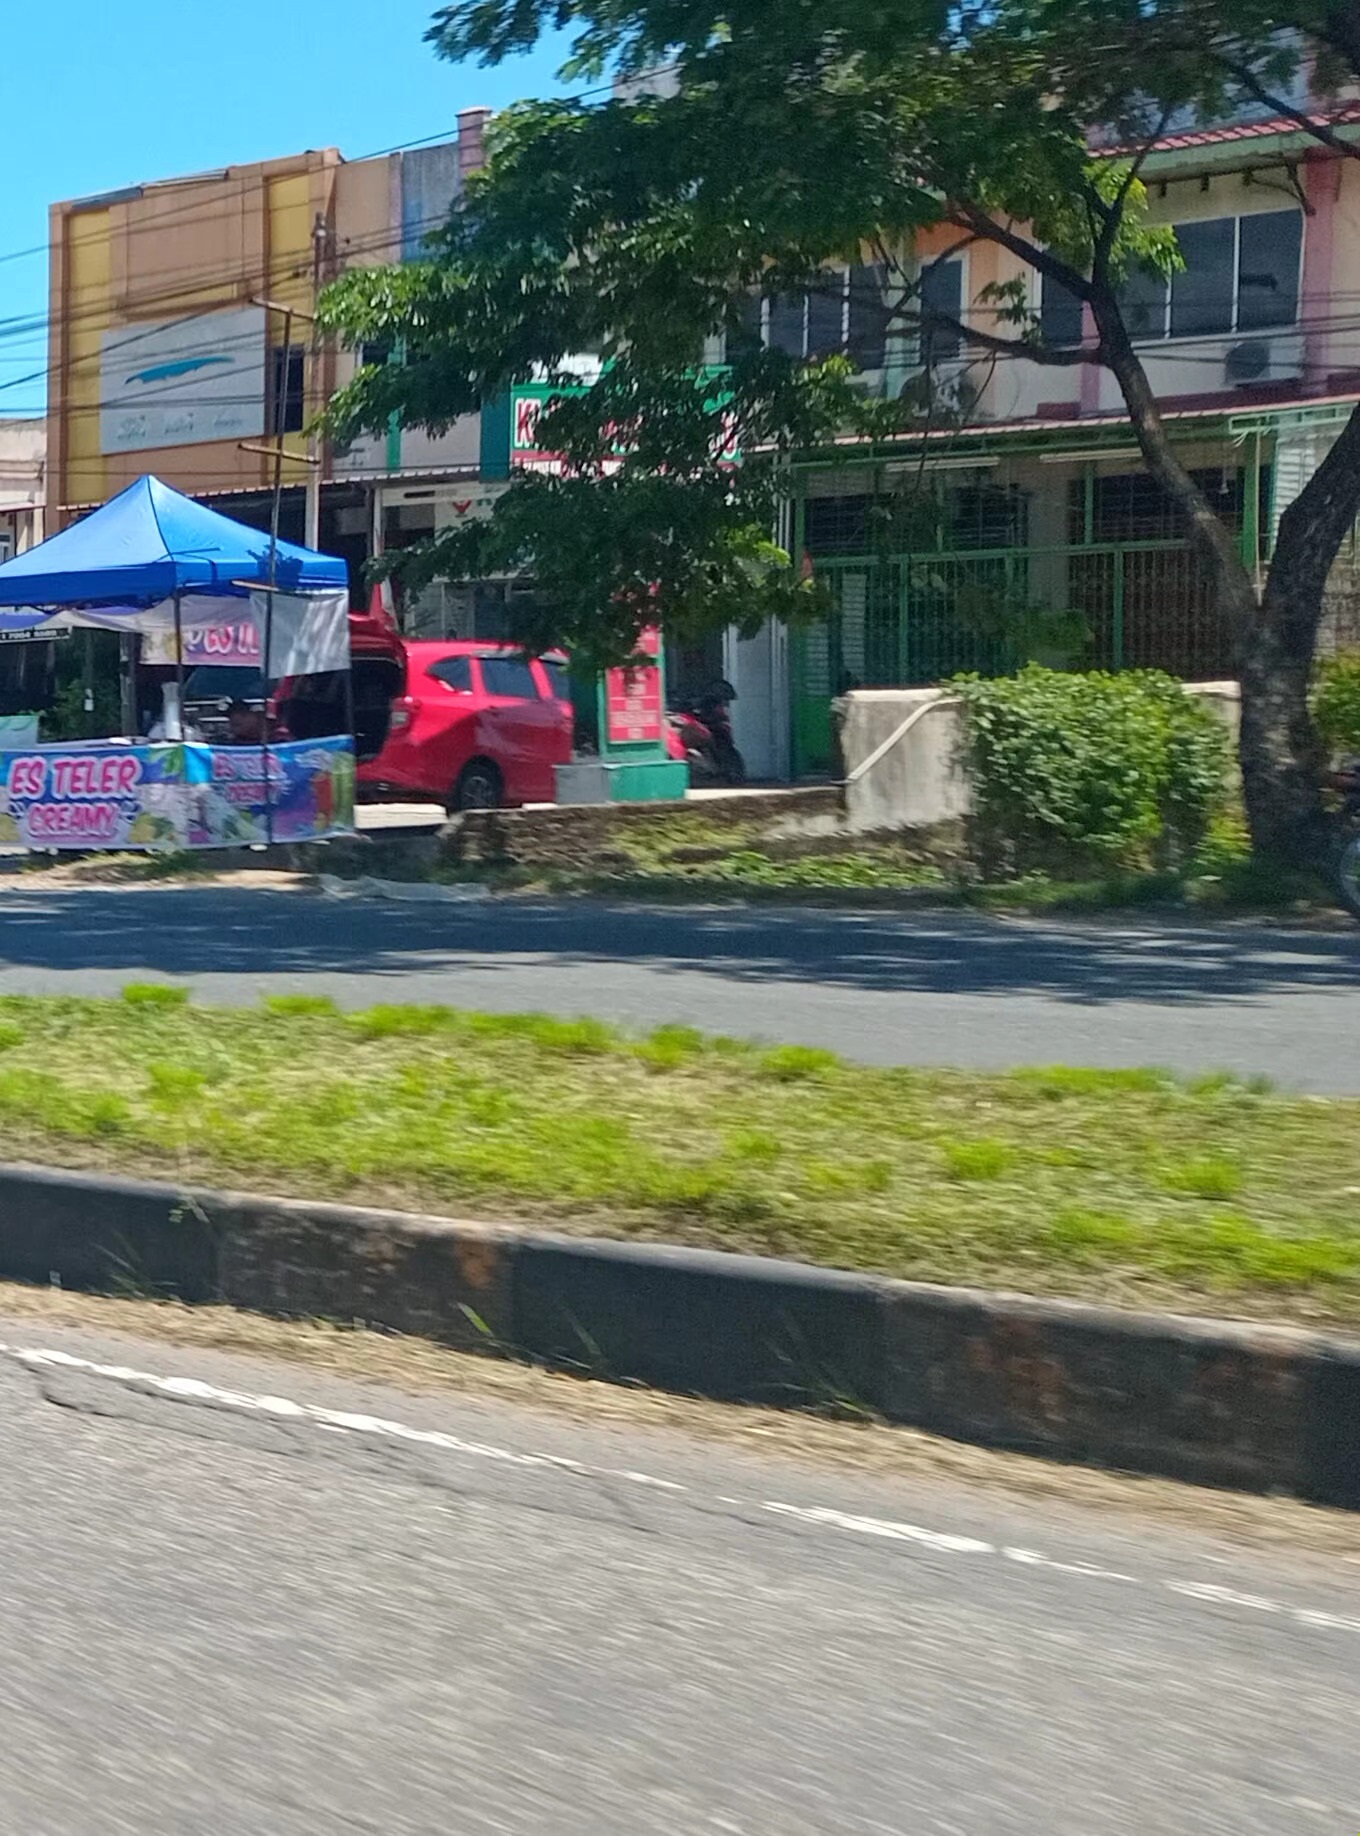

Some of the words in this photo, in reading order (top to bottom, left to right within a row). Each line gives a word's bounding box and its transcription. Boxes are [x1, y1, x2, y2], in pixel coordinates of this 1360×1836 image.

[9, 757, 46, 797] ES
[52, 757, 141, 797] TELER
[29, 803, 118, 835] CREAMY
